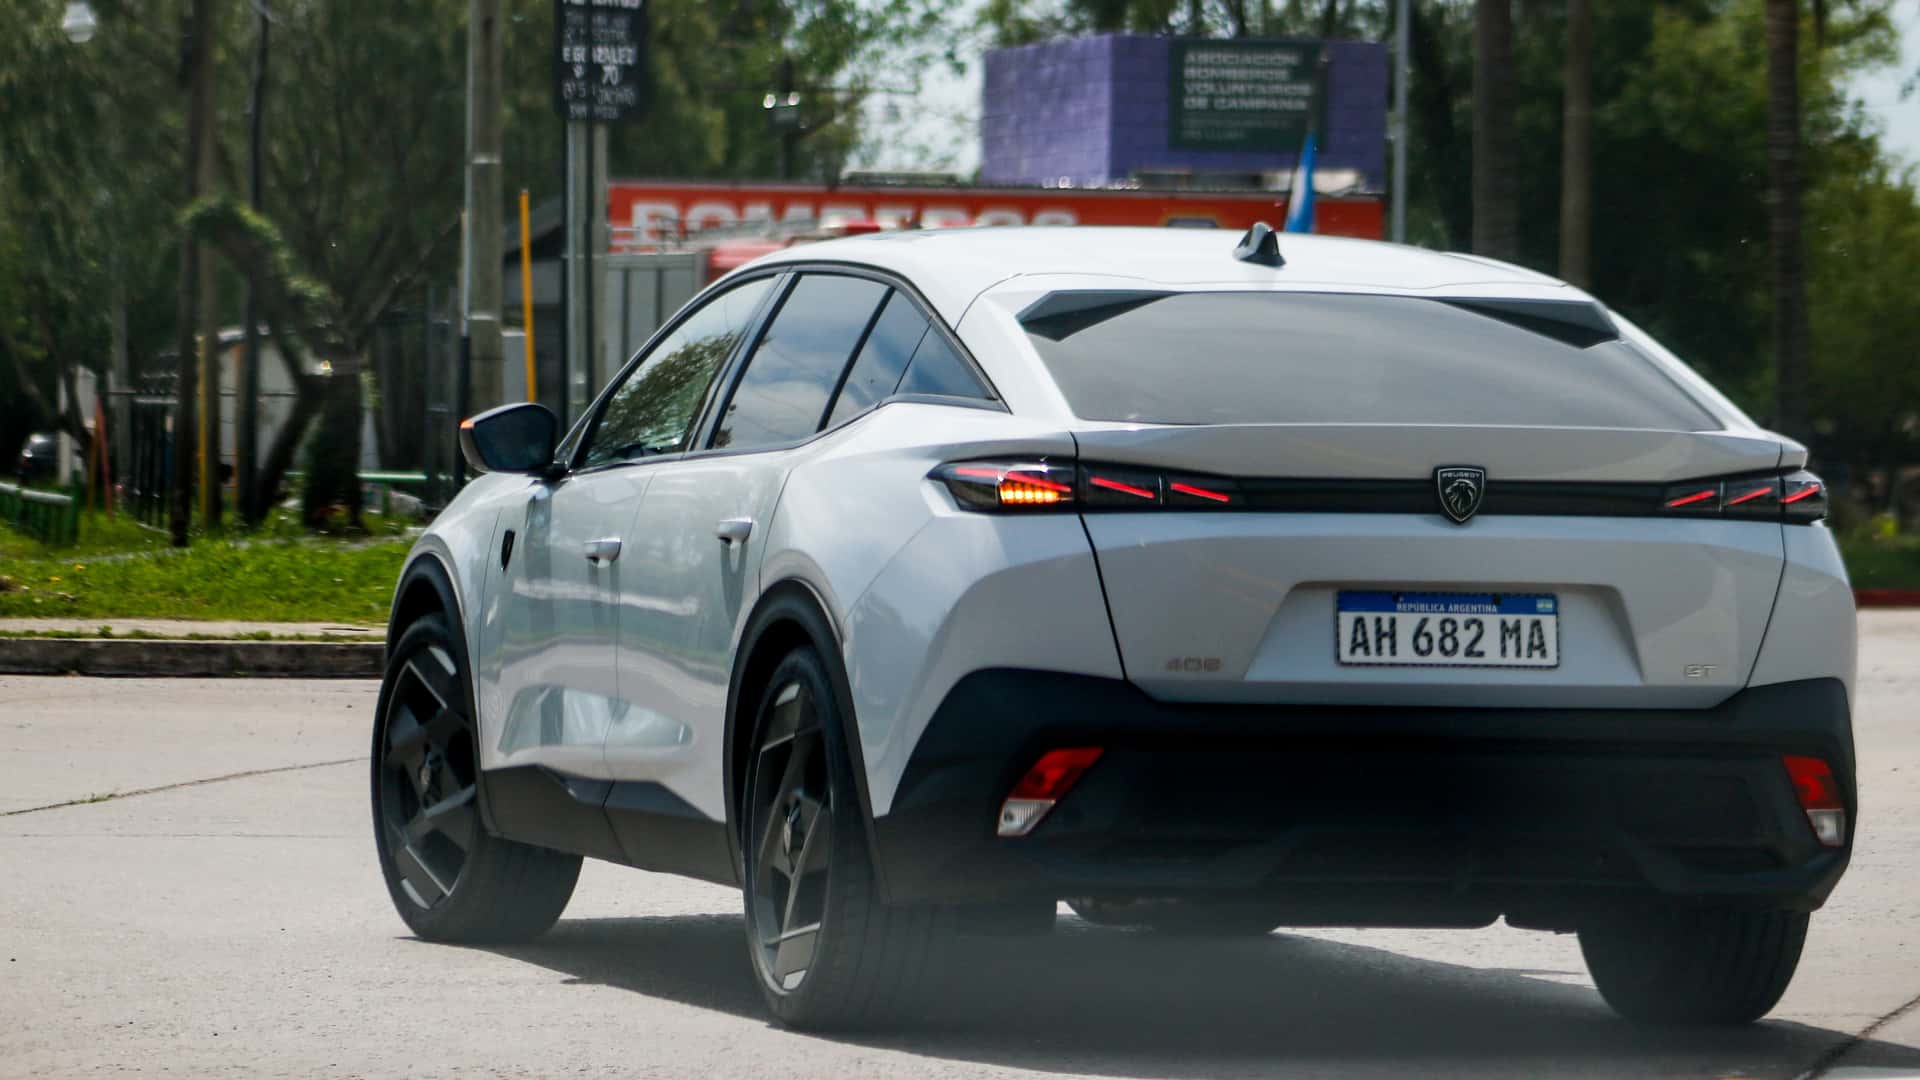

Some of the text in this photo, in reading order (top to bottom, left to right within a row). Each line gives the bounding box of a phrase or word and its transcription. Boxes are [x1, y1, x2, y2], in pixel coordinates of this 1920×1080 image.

[1184, 97, 1308, 111] DE CAMPANA
[1397, 602, 1498, 613] REPÚBLICA ARGENTINA
[1349, 615, 1548, 659] AH 682 MA
[1683, 664, 1719, 679] GT
